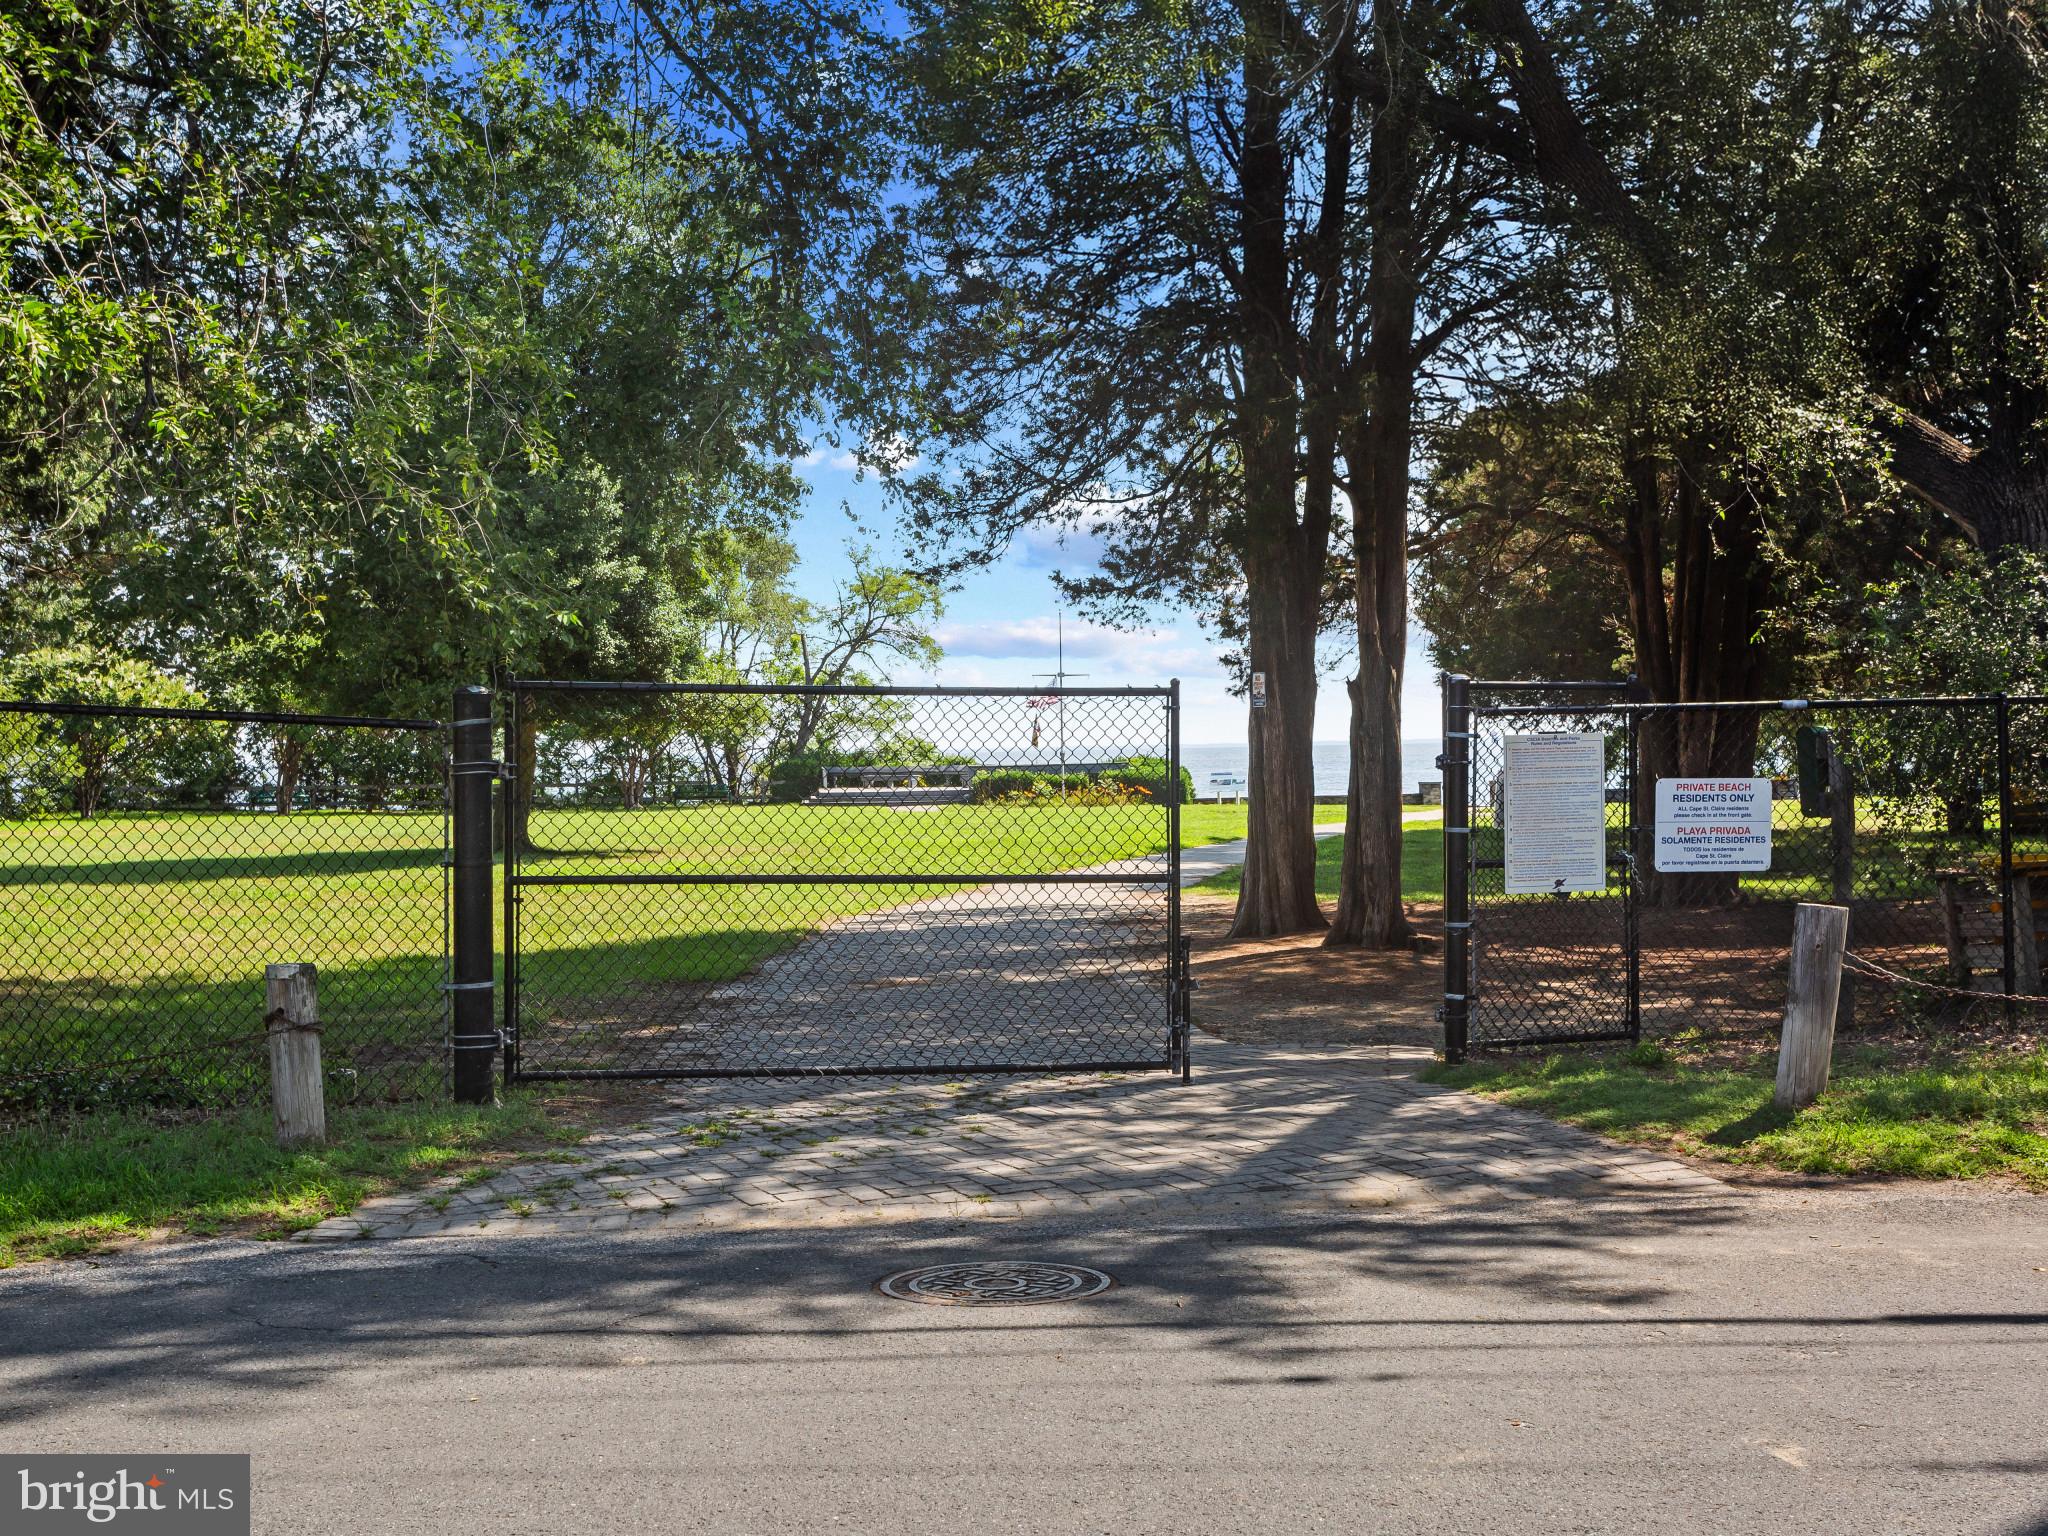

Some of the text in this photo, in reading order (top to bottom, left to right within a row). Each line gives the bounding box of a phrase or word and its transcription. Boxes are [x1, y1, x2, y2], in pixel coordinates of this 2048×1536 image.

[1676, 783, 1751, 792] PRIVATE BEACH
[1672, 794, 1754, 802] RESIDENTS ONLY
[1677, 826, 1752, 835] PLAYA PRIVADA
